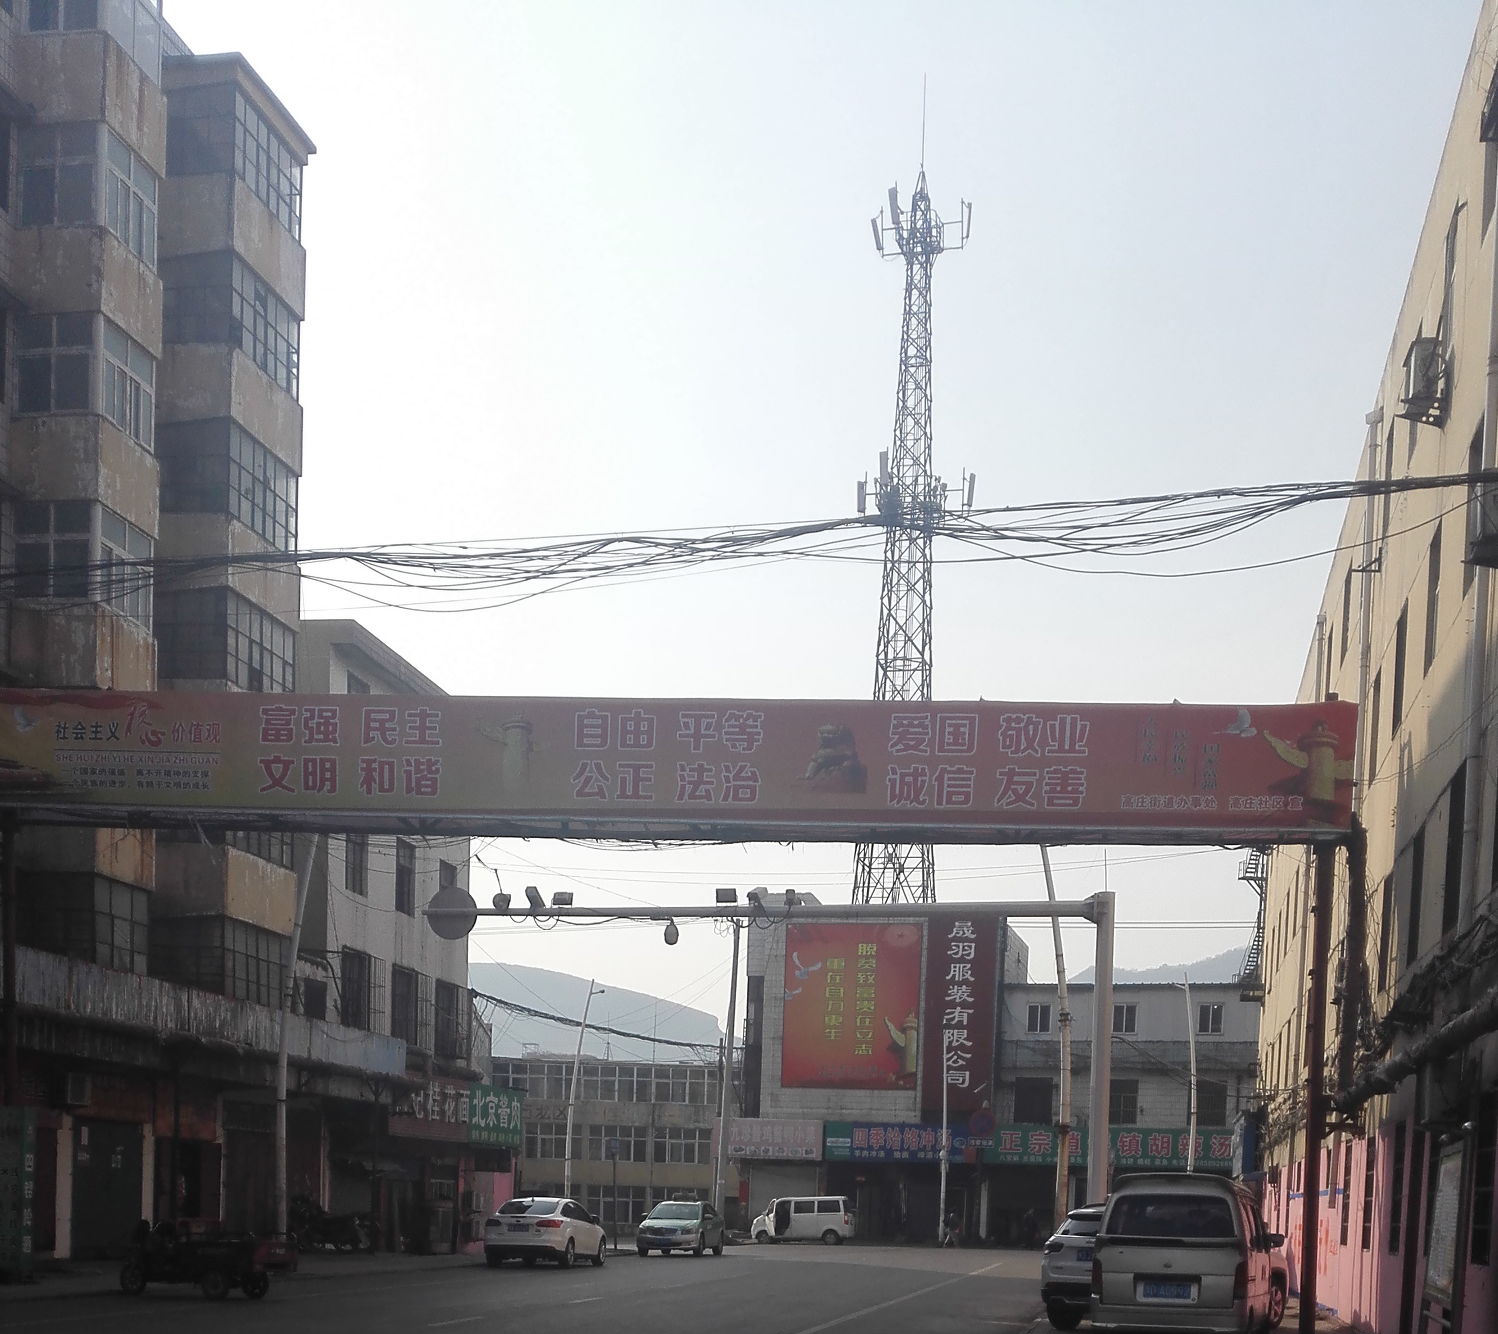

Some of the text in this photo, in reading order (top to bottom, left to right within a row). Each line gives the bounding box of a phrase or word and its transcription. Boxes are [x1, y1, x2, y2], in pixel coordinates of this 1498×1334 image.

[259, 705, 443, 747] 富强 民主
[574, 708, 765, 753] 自由 平等
[888, 713, 979, 756] 爱国
[998, 713, 1091, 757] 敬业
[258, 754, 442, 798] 文明 和谐
[571, 760, 761, 804] 公正 法治
[887, 765, 1087, 809] 诚信 友善
[1121, 794, 1217, 810] 高庄街道办事处
[1229, 795, 1285, 811] 高庄社区
[824, 958, 845, 1041] 重在自力更生
[854, 943, 877, 1055] 脱贫致富贵在立志
[943, 920, 977, 1088] 晟羽服装有限公司
